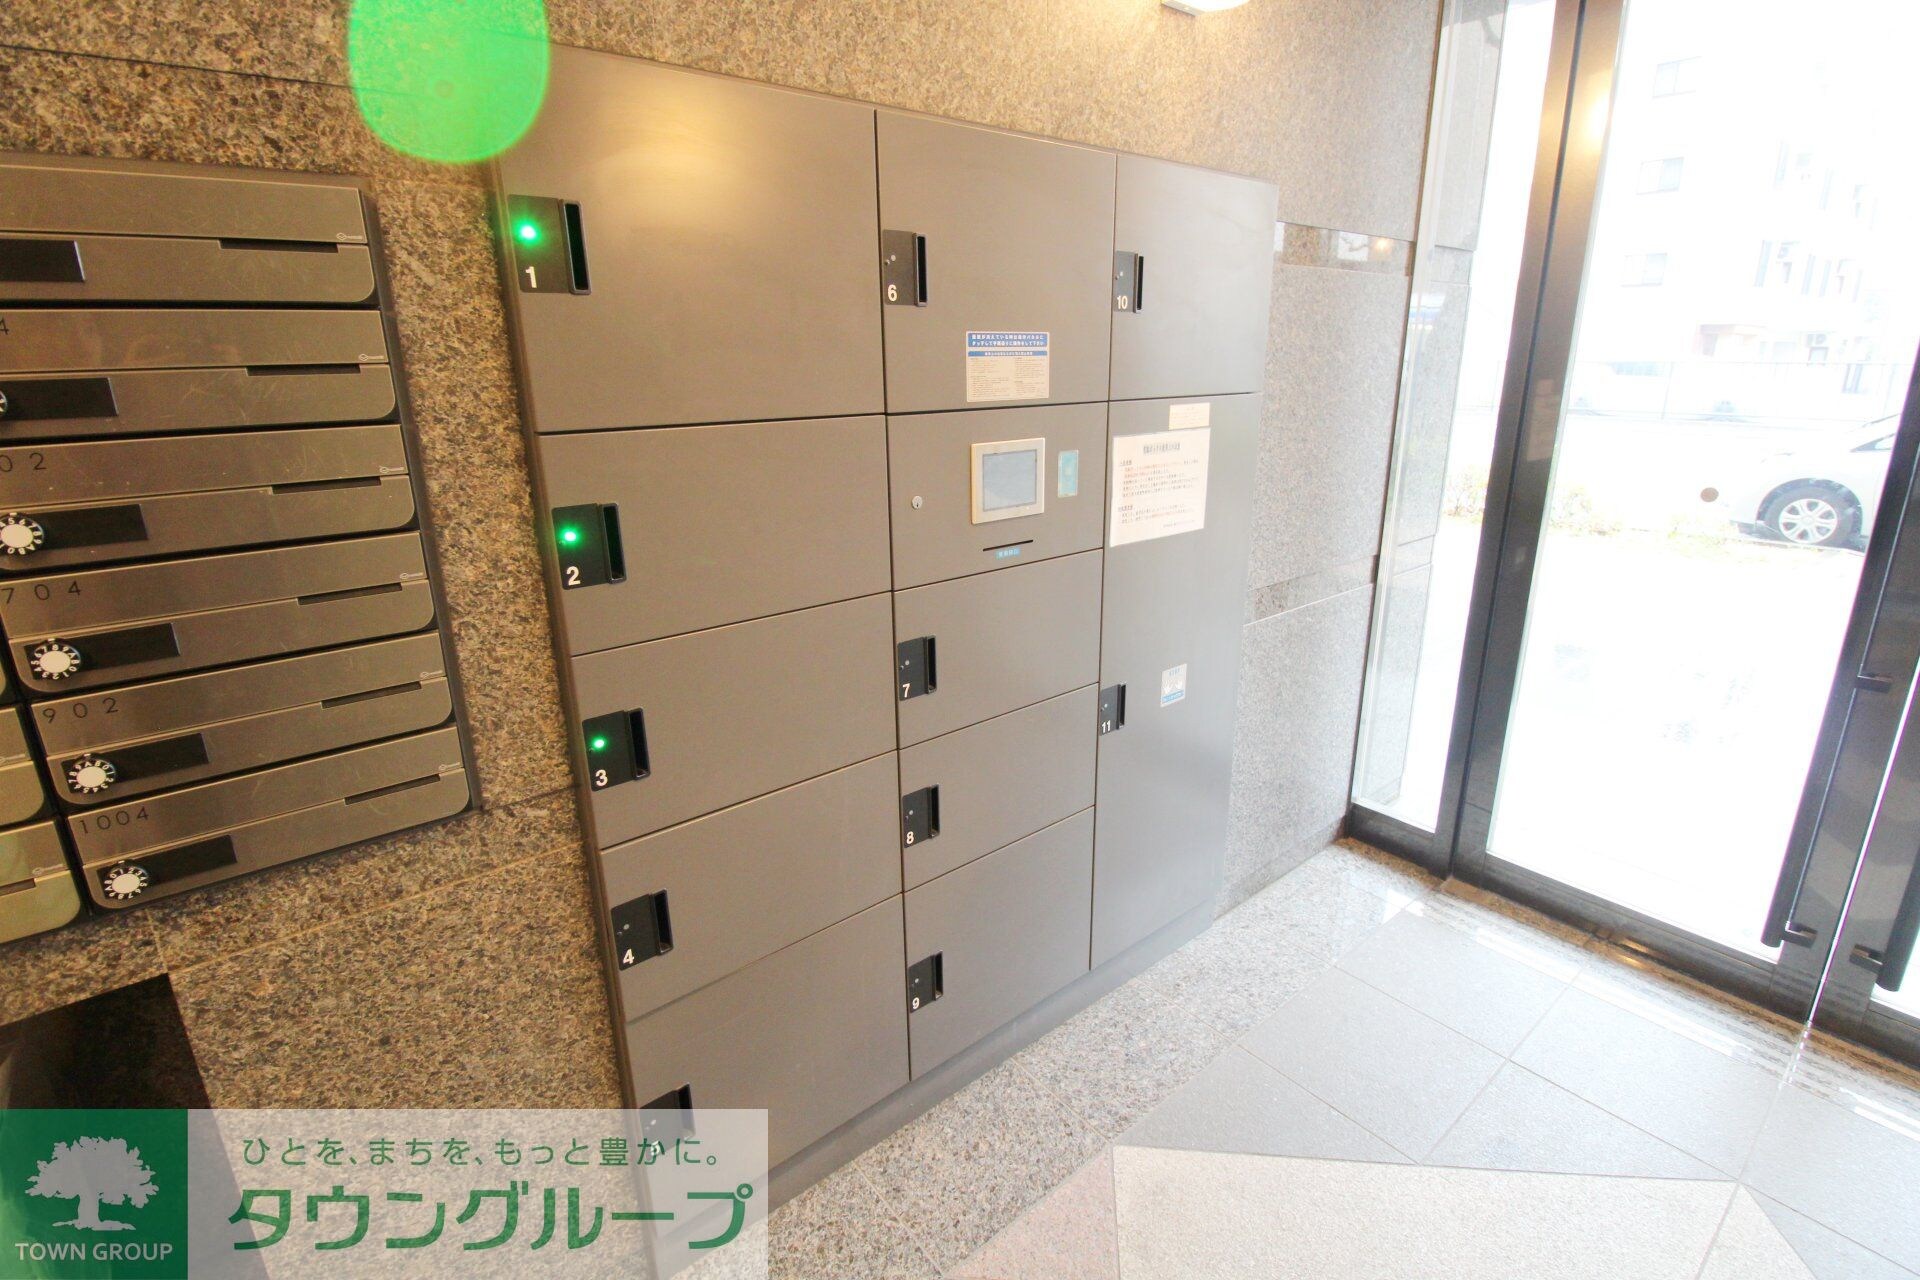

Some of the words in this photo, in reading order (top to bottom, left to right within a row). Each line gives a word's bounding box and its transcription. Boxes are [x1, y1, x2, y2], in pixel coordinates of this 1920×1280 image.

[525, 266, 537, 289] 1
[887, 284, 898, 302] 6
[1117, 295, 1128, 310] 10
[566, 566, 581, 586] 2
[902, 683, 911, 698] 7
[1101, 720, 1111, 733] 11
[595, 769, 608, 787] 3
[79, 806, 150, 834] 1004
[906, 831, 914, 844] 8
[623, 948, 635, 965] 4
[912, 996, 920, 1010] 9
